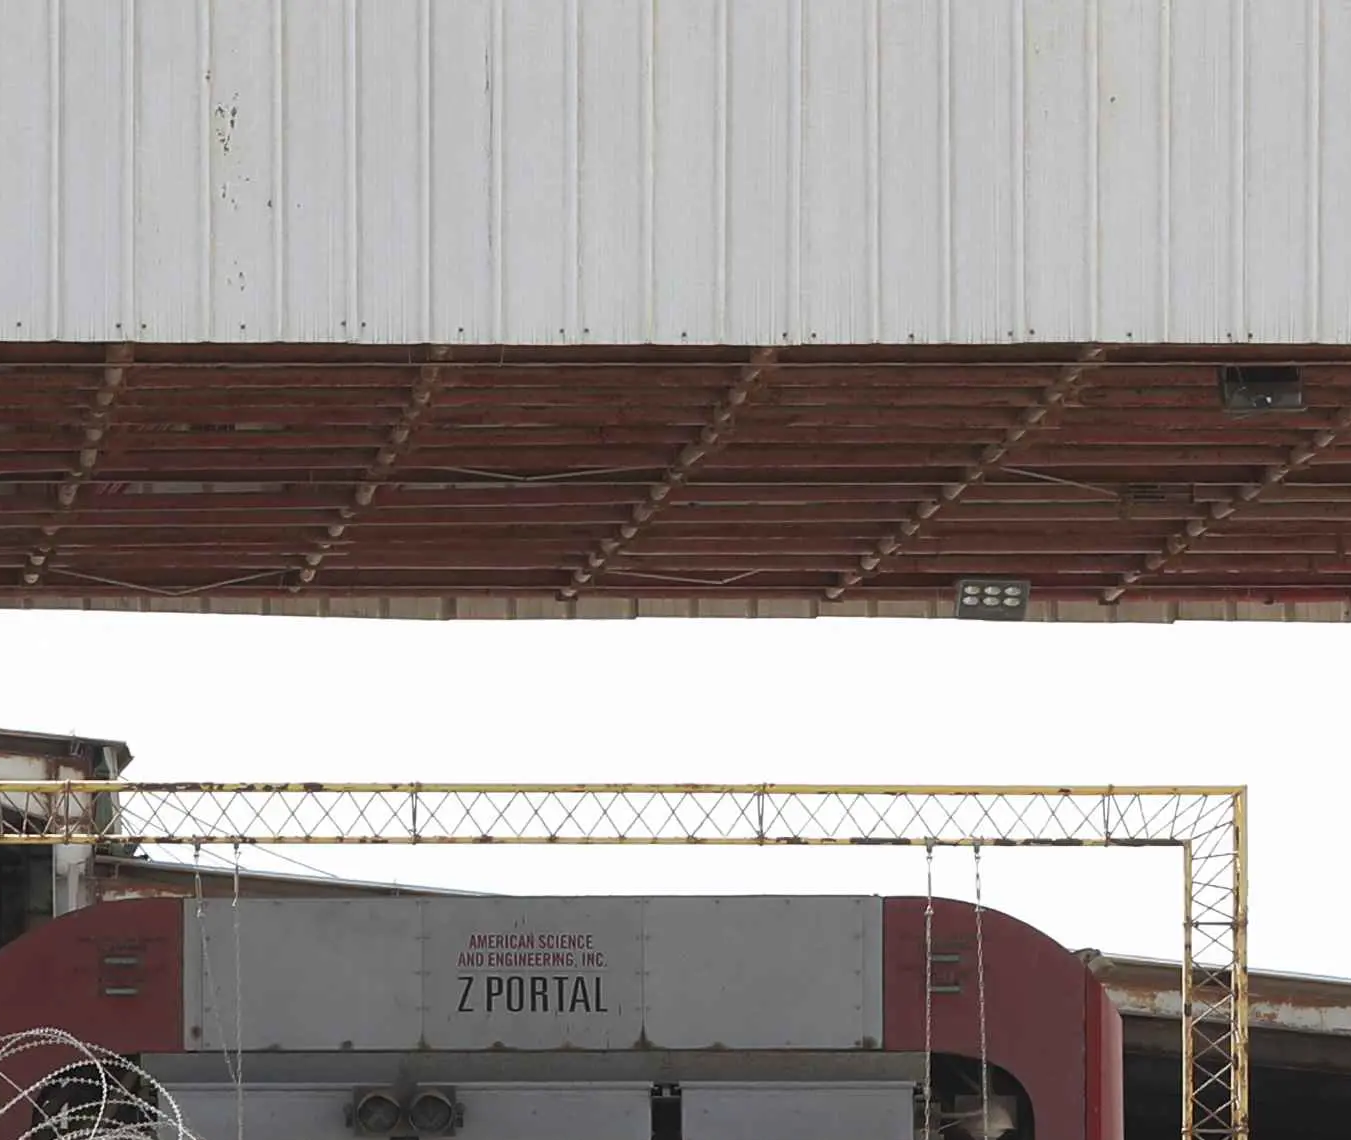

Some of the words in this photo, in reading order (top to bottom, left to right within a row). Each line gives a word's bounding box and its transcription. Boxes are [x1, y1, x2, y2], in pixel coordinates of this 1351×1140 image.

[468, 934, 535, 949] AMERICAN
[538, 934, 594, 949] SCIENCE
[457, 952, 484, 967] AND
[487, 952, 578, 969] ENGINEERING,
[581, 952, 608, 968] INC.
[457, 976, 475, 1012] Z
[485, 976, 608, 1012] PORTAL
